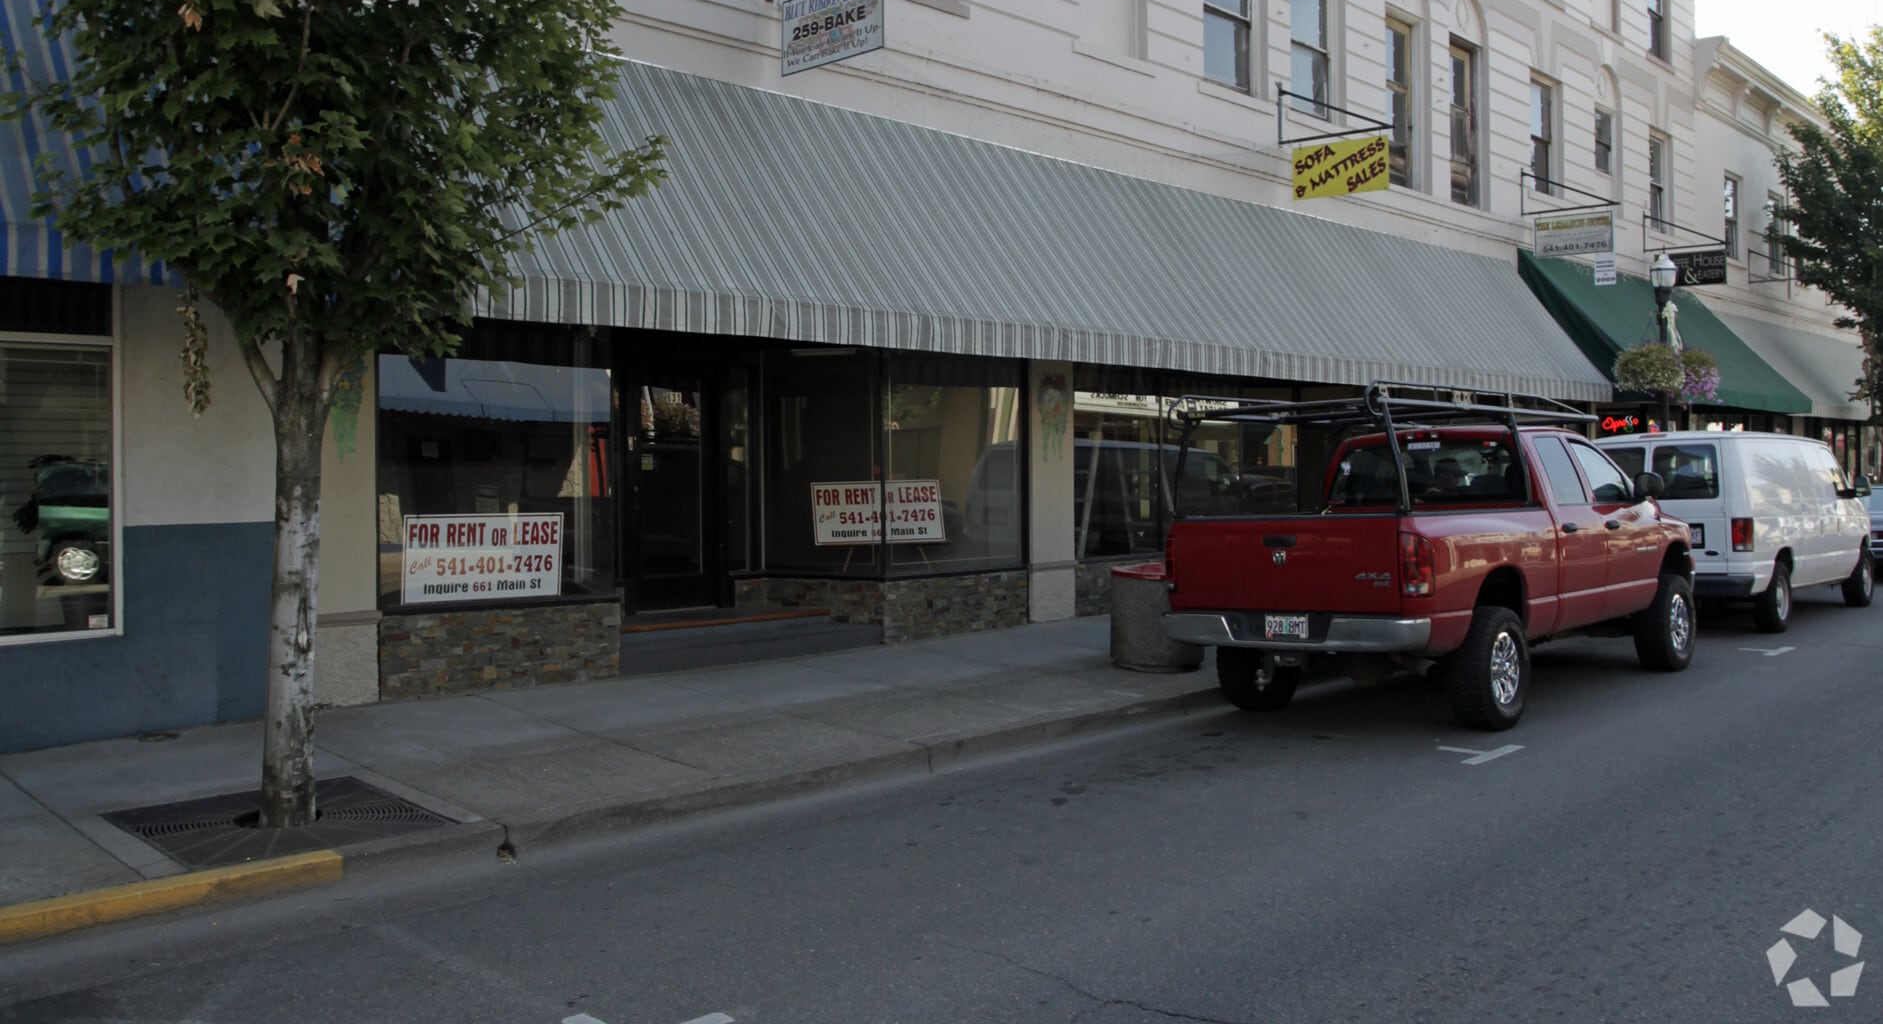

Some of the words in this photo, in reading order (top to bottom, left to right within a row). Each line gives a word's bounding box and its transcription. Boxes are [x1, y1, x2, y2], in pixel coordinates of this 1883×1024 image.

[785, 0, 807, 22] BLUE
[792, 4, 867, 42] 259-BAKE
[787, 56, 801, 68] We
[802, 50, 820, 64] Can
[1294, 144, 1336, 176] SOFA
[1295, 184, 1307, 198] &
[1309, 137, 1385, 191] MATTRESS
[1346, 156, 1386, 192] SALES
[1684, 267, 1700, 284] &
[816, 488, 840, 506] FOR
[844, 487, 876, 505] RENT
[897, 486, 937, 504] LEASE
[819, 510, 836, 523] Call
[839, 509, 936, 524] 541-41-7476
[409, 523, 440, 549] FOR
[446, 522, 486, 547] RENT
[491, 528, 507, 546] OR
[513, 521, 558, 546] LEASE
[831, 529, 868, 538] Inquire
[890, 527, 915, 536] Main
[917, 527, 928, 535] St
[409, 555, 432, 575] Call
[436, 554, 553, 576] 541-401-7476
[423, 581, 469, 595] Inquire
[472, 581, 493, 593] 661
[496, 579, 526, 591] Main
[529, 578, 542, 589] St
